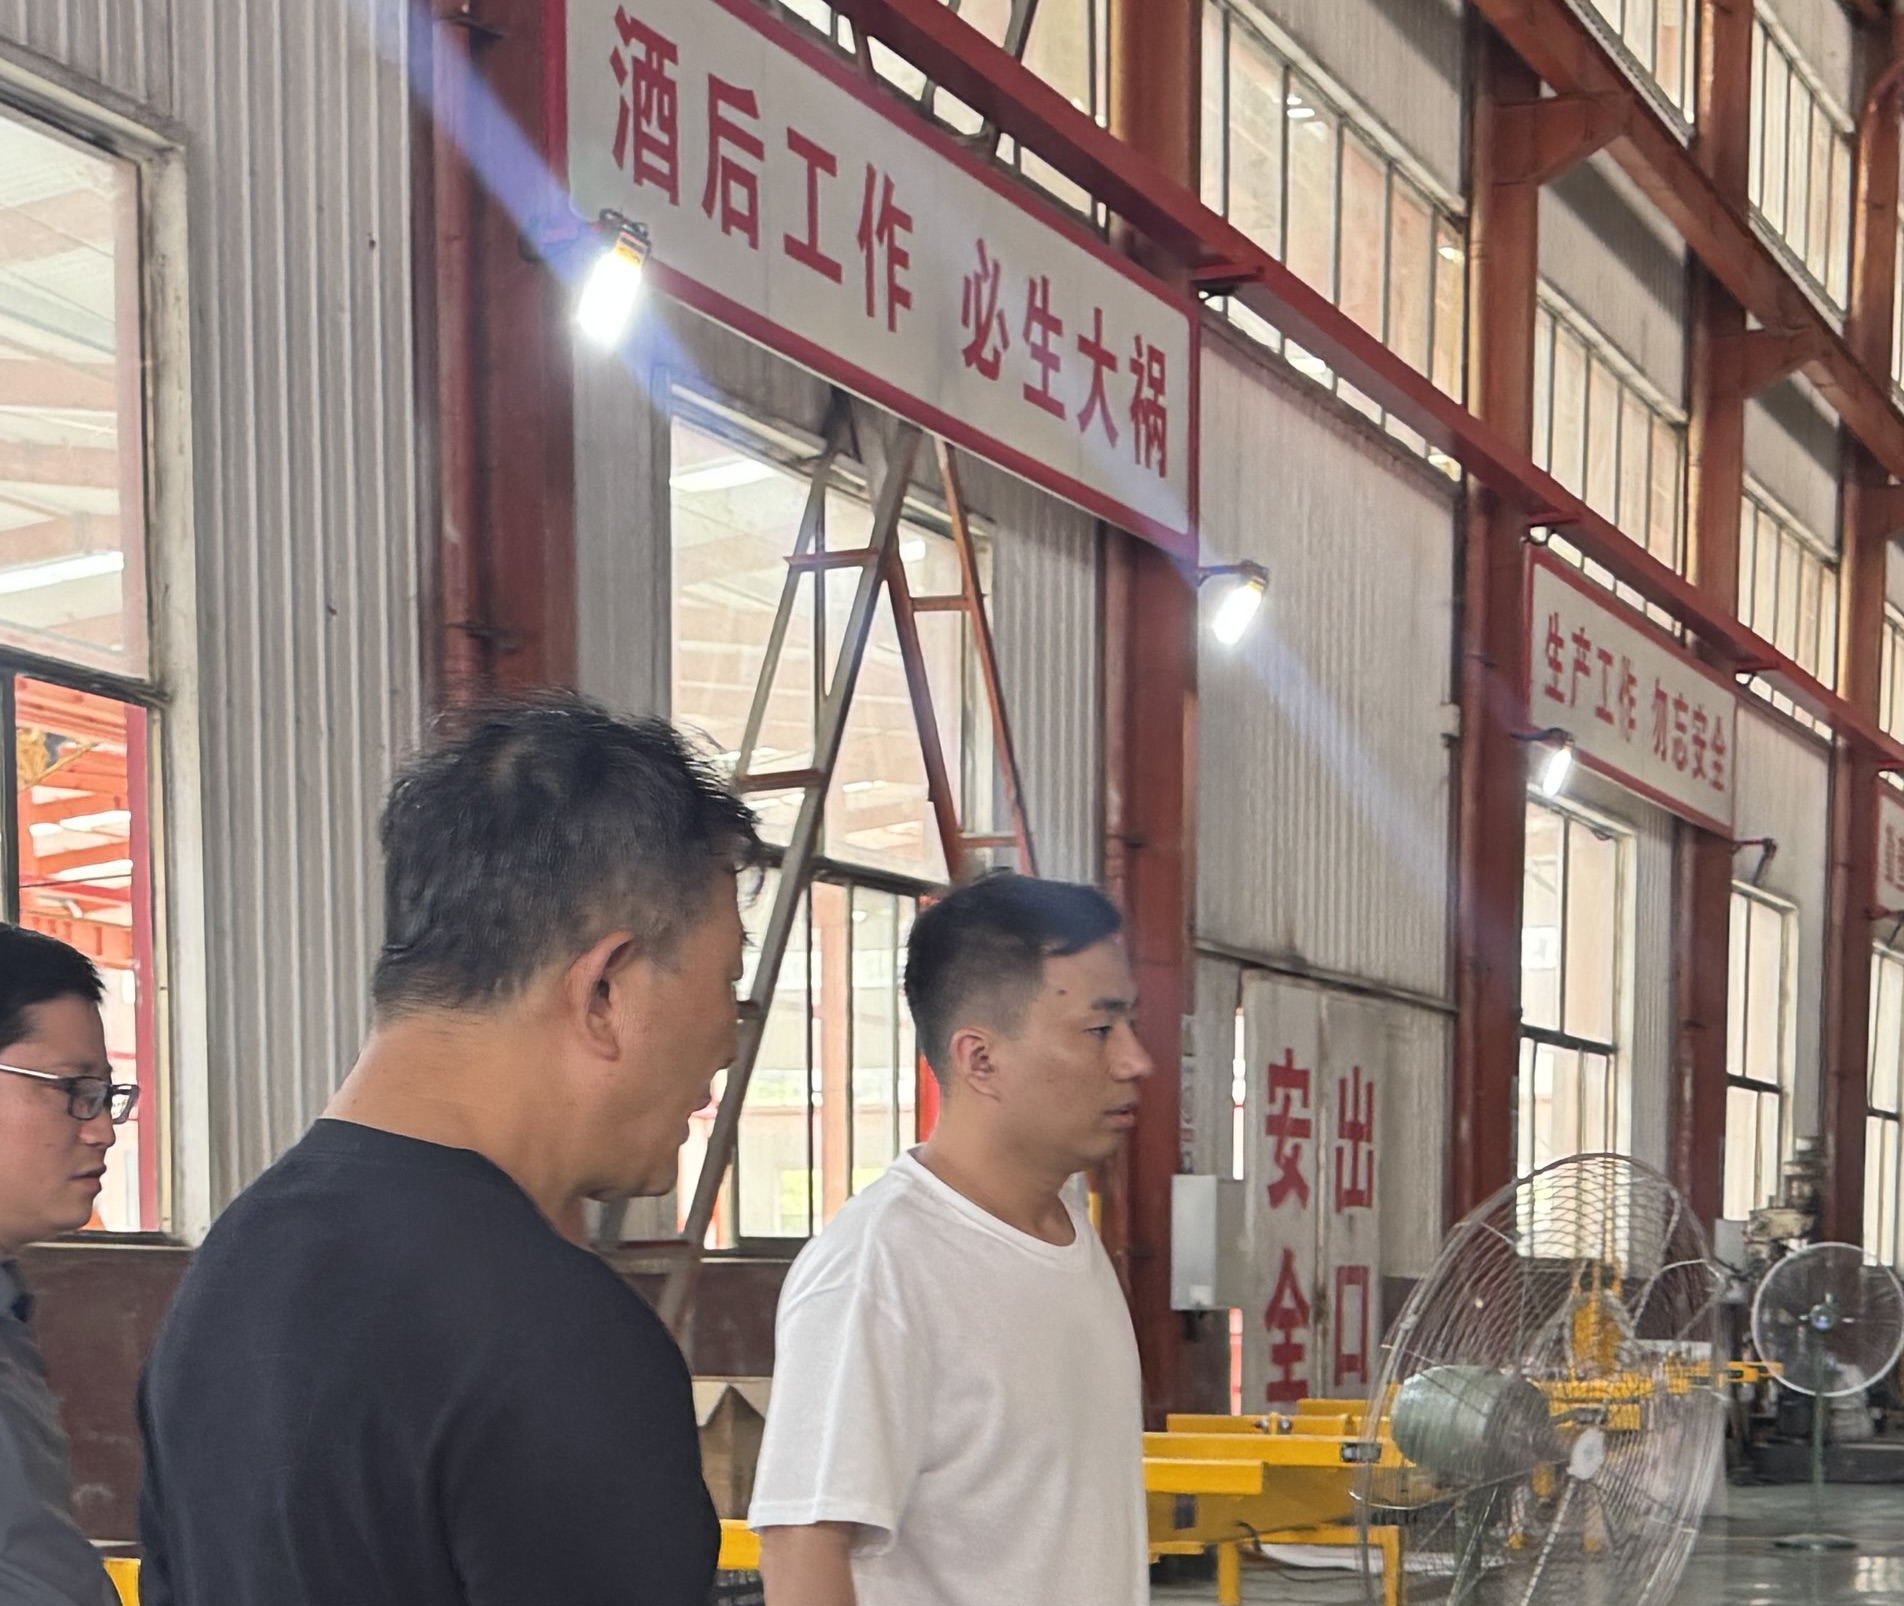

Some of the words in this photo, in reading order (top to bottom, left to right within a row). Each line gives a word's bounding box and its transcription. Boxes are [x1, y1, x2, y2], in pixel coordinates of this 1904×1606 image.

[610, 5, 913, 333] 酒后工作
[961, 237, 1168, 479] 必生大祸
[1544, 611, 1637, 743] 生产工作
[1652, 677, 1726, 791] 勿忘安全
